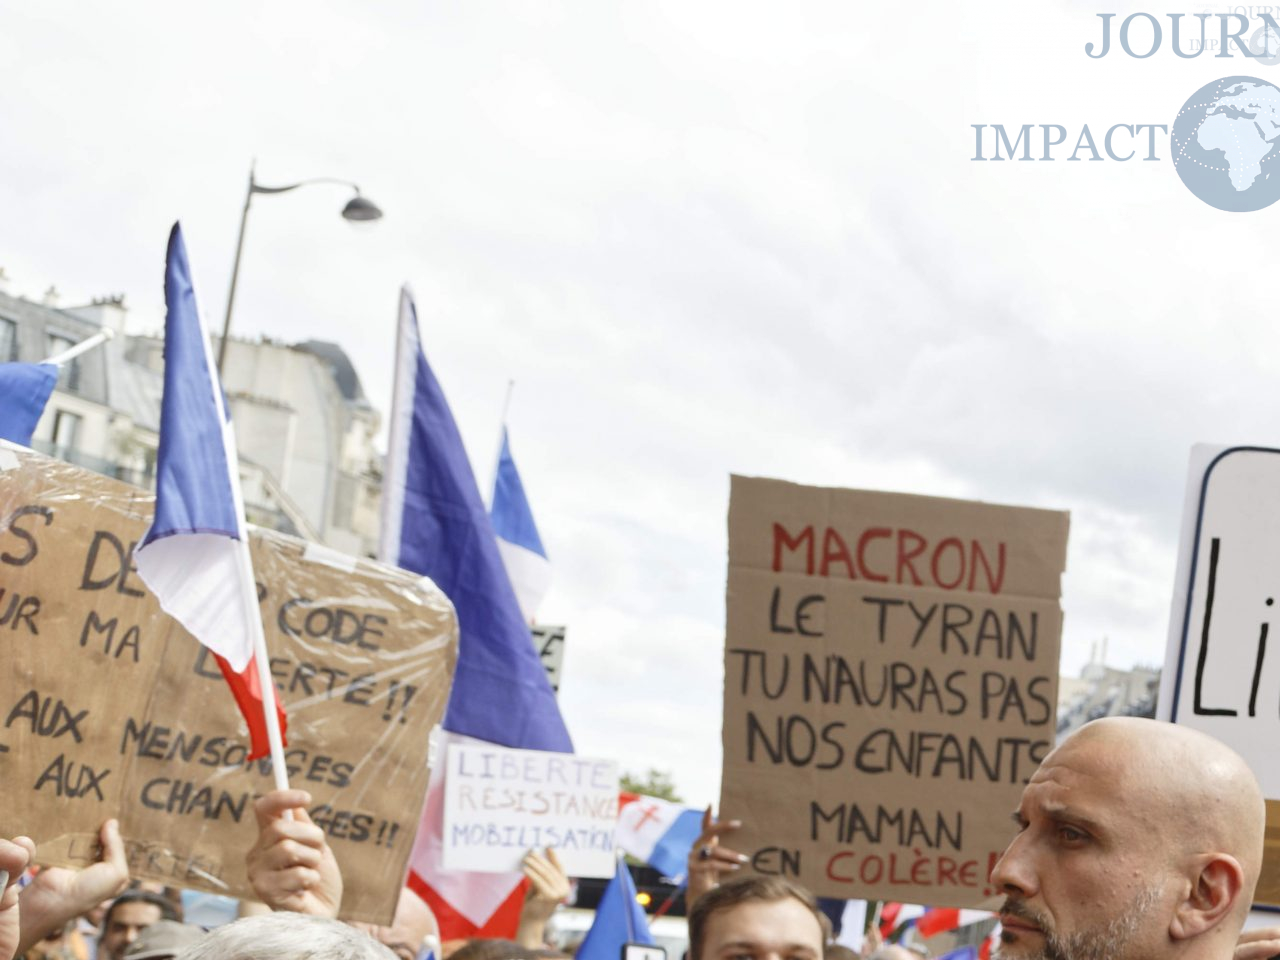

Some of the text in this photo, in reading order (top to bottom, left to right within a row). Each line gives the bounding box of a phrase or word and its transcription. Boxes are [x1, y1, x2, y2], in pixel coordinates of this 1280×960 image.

[772, 522, 1006, 594] MACRON
[278, 597, 388, 651] CODE
[770, 587, 1038, 661] LE TYRAN
[80, 611, 140, 663] MA
[194, 645, 417, 724] LERTE!!
[730, 649, 789, 699] TU
[981, 671, 1051, 726] PAS
[5, 690, 89, 743] AUX
[747, 711, 1050, 784] NOS ENFANTS
[33, 753, 400, 848] AUX CHANGES!!
[810, 801, 962, 850] MAMAN
[752, 847, 800, 877] EN
